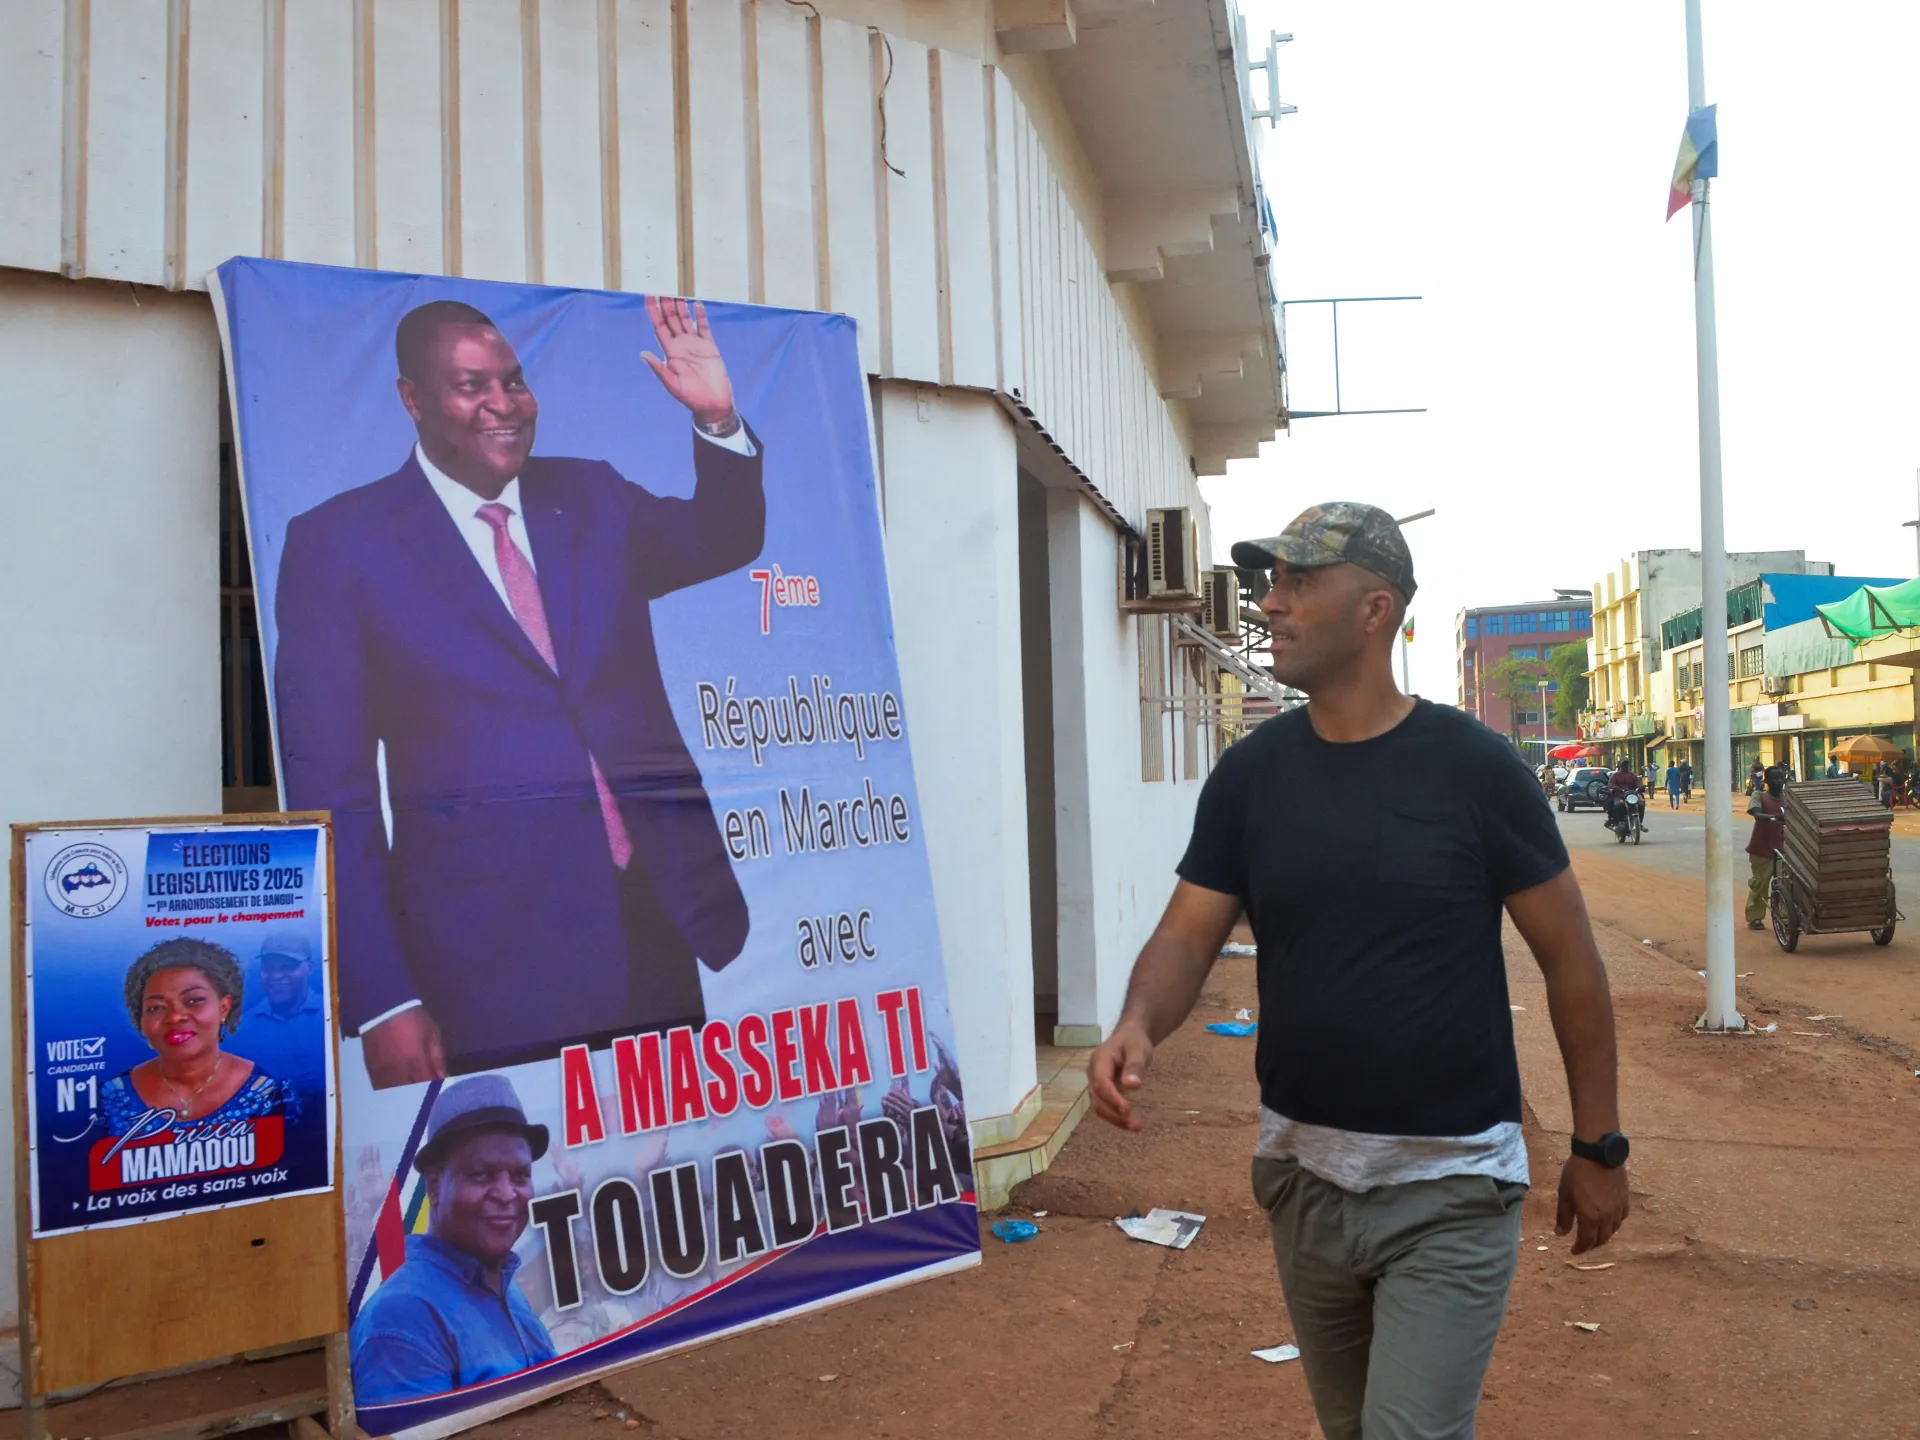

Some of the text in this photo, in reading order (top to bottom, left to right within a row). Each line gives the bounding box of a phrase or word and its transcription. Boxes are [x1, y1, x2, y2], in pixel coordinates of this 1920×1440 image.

[750, 564, 820, 634] 7ème
[697, 673, 901, 765] République
[724, 778, 911, 862] en Marche
[183, 842, 270, 867] ELECTIONS
[148, 867, 303, 896] LEGISLATIVES 2025
[168, 896, 249, 911] ARRONDISSEMENT
[250, 895, 261, 907] DE
[263, 894, 294, 906] BANGUI
[145, 909, 304, 927] Votez pour le changement
[797, 909, 876, 969] avec
[46, 1039, 81, 1062] VOTE
[47, 1061, 106, 1075] CANDIDATE
[560, 986, 929, 1149] A MASSEKA TI
[102, 1108, 256, 1165] Prisca
[121, 1133, 256, 1184] MAMADOU
[86, 1168, 289, 1211] La voix des sans voix
[529, 1105, 960, 1312] TOUADERA
